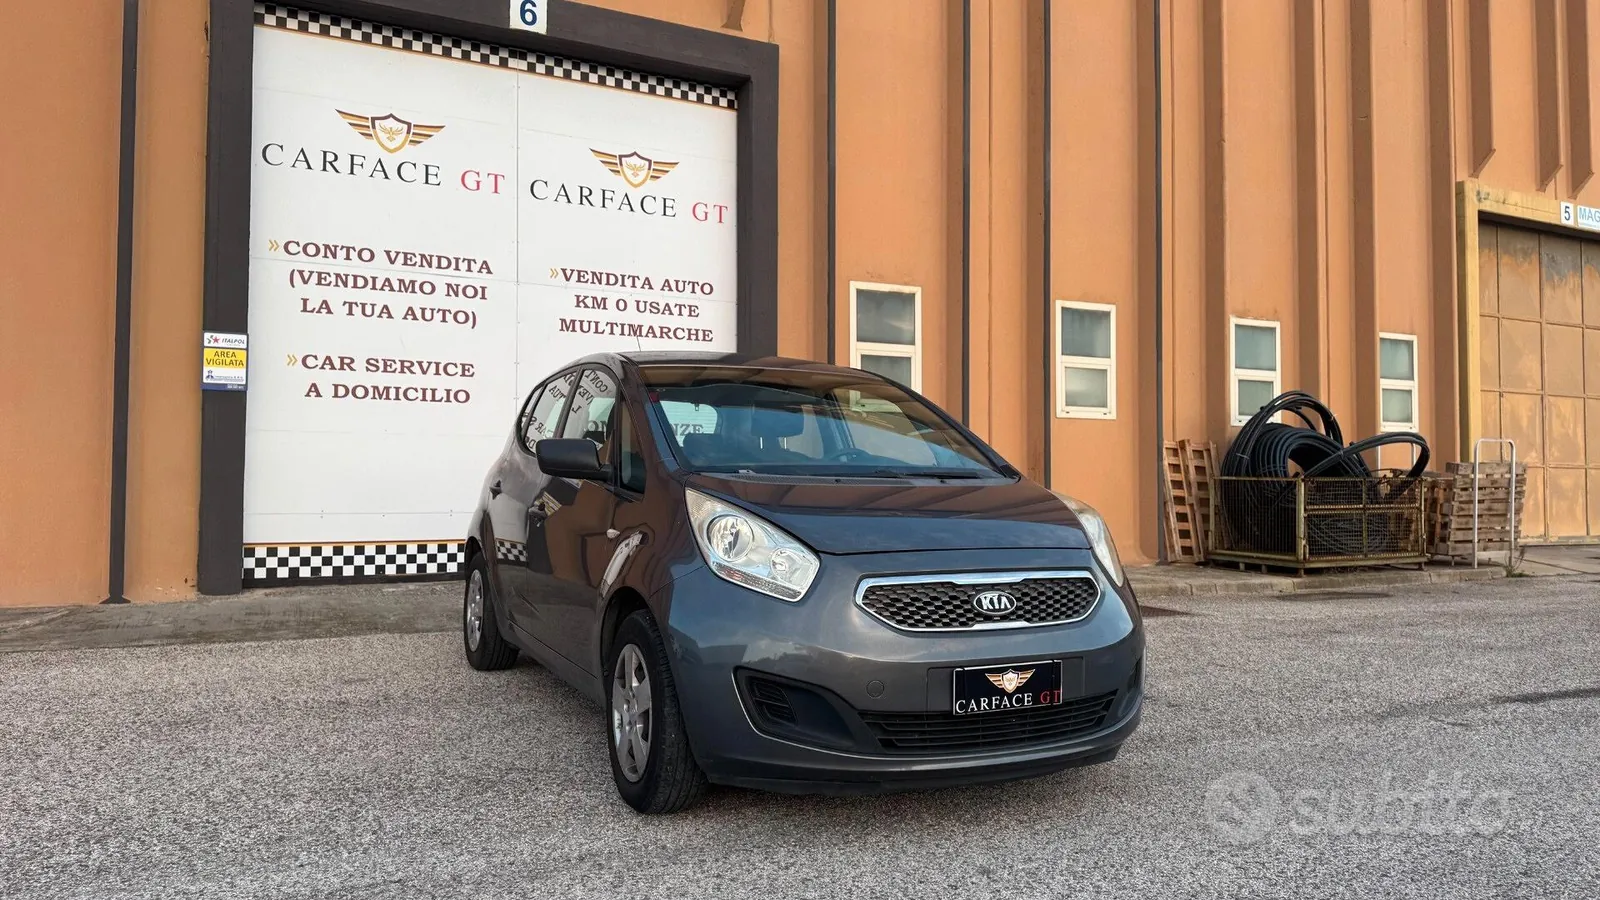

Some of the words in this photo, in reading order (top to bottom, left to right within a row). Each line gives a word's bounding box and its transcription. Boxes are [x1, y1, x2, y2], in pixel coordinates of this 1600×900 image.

[519, 0, 538, 26] 6
[261, 142, 442, 186] CARFACE
[460, 169, 505, 194] GT
[529, 179, 677, 217] CARFACE
[692, 201, 728, 223] GT
[1564, 205, 1571, 221] 5
[283, 240, 376, 263] CONTO
[383, 249, 494, 275] VENDITA
[289, 268, 437, 296] (VENDIAMO
[444, 282, 488, 300] NOI
[560, 267, 654, 291] VENDITA
[660, 278, 714, 296] AUTO
[300, 297, 334, 315] LA
[342, 300, 394, 320] TUA
[402, 306, 477, 330] AUTO)
[574, 294, 609, 311] KM
[635, 299, 700, 318] USATE
[559, 318, 714, 343] MULTIMARCHE
[205, 358, 244, 367] VIGILATA
[213, 350, 237, 358] AREA
[301, 354, 357, 372] CAR
[365, 357, 476, 378] SERVICE
[304, 382, 323, 398] A
[331, 383, 471, 404] DOMICILIO
[980, 593, 1011, 610] KIA
[955, 692, 1033, 713] CARFACE
[1040, 690, 1060, 704] GT
